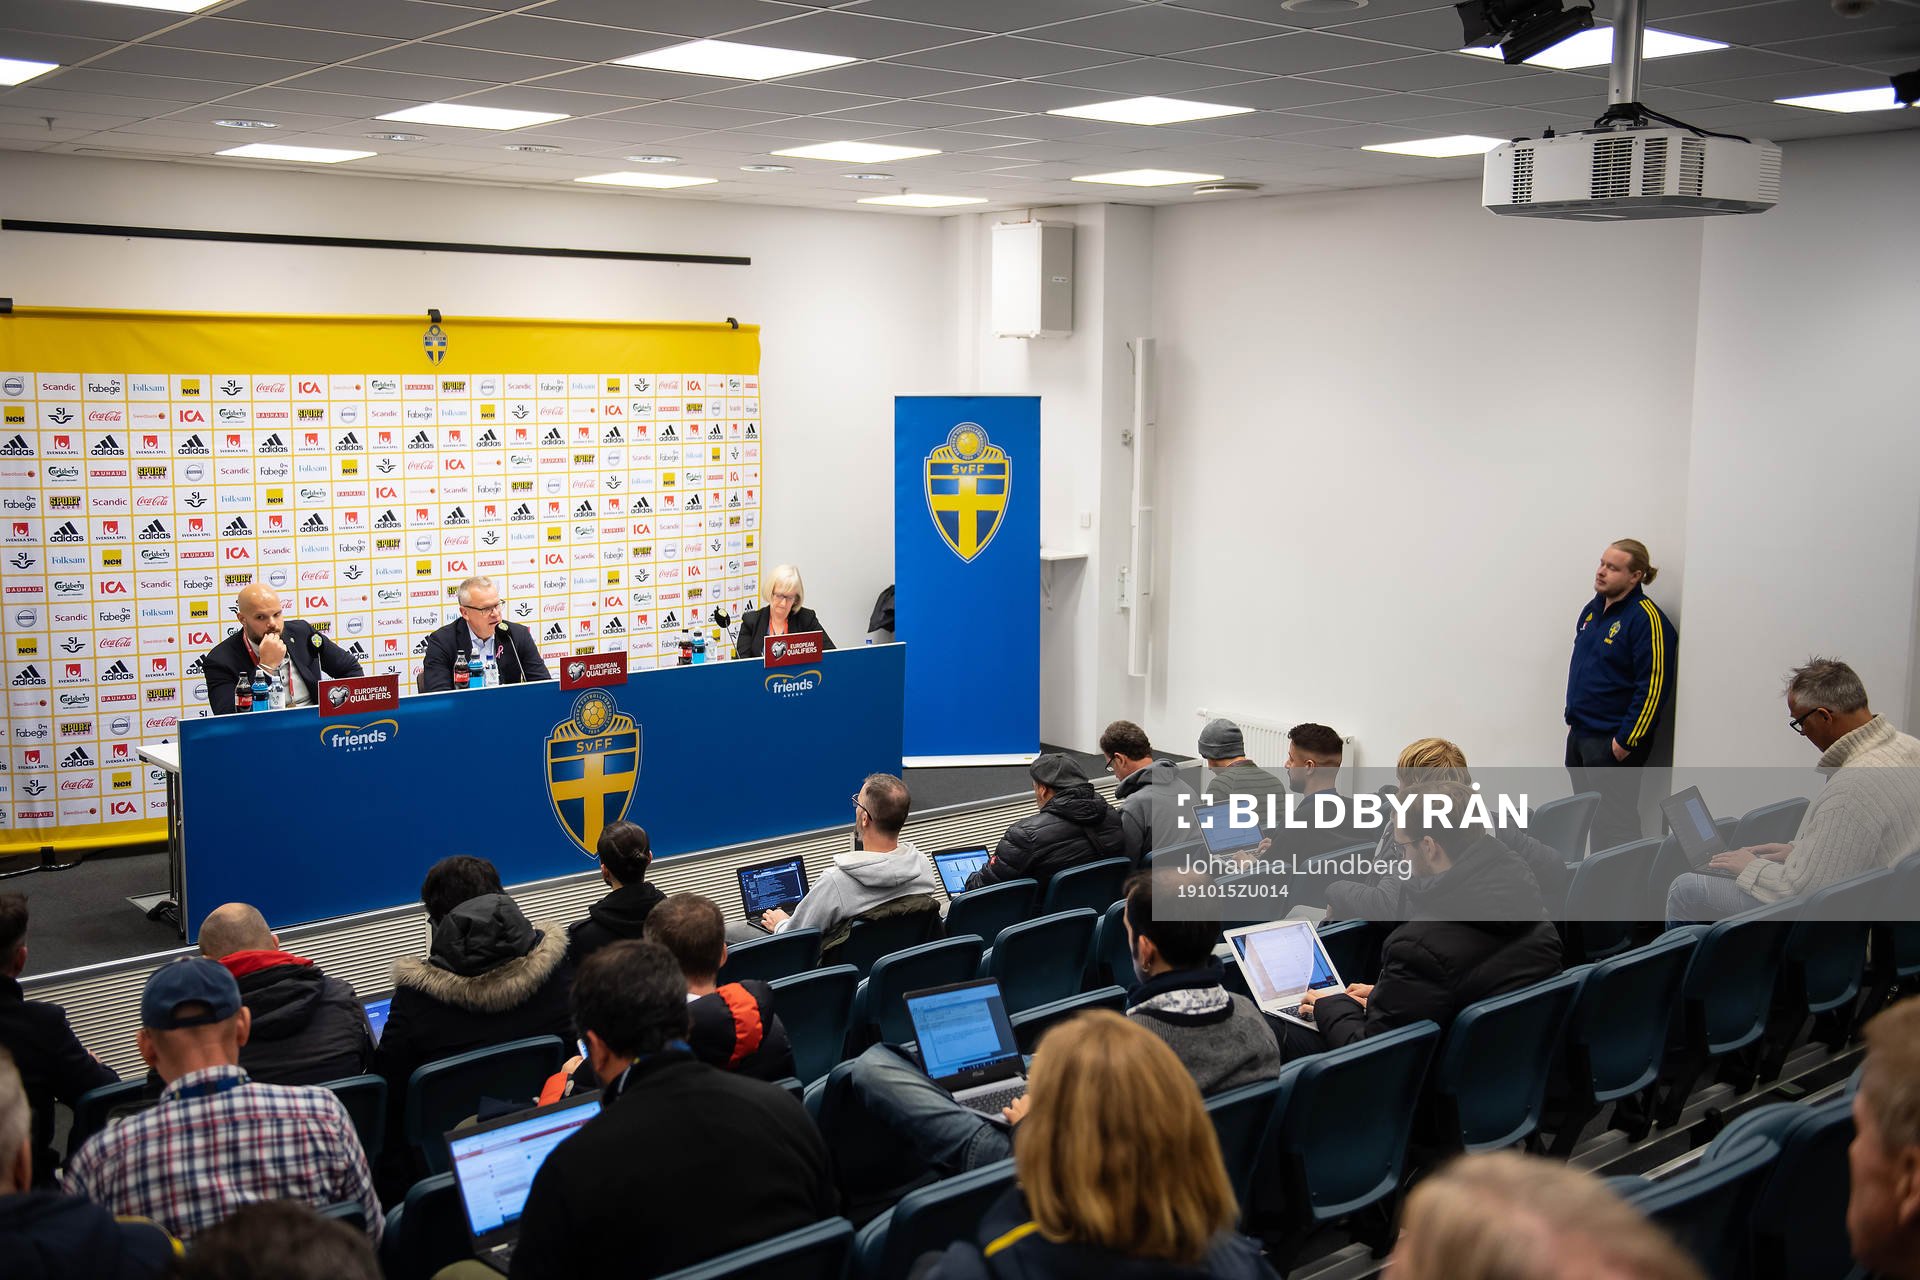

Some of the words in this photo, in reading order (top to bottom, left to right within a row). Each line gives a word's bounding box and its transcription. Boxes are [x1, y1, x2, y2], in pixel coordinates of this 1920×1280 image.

[42, 383, 76, 391] Scandic
[133, 383, 165, 392] Folksam
[227, 379, 236, 387] SJ
[298, 381, 322, 394] ICA
[687, 380, 702, 390] ICA
[88, 383, 121, 396] Fabege
[56, 407, 66, 416] SJ
[219, 408, 246, 420] Carlsberg
[605, 405, 622, 416] ICA
[179, 410, 205, 423] ICA
[407, 441, 434, 449] adidas
[476, 440, 502, 448] adidas
[541, 438, 566, 446] adidas
[178, 447, 210, 455] adidas
[258, 445, 289, 453] adidas
[335, 443, 364, 451] adidas
[0, 448, 35, 456] adidas
[91, 448, 125, 456] adidas
[445, 459, 465, 470] ICA
[49, 465, 79, 478] Carlsberg
[137, 466, 167, 476] SPORT
[220, 467, 250, 475] Scandic
[260, 466, 288, 478] Fabege
[951, 464, 985, 475] SvFF
[191, 491, 200, 499] SJ
[376, 487, 397, 498] ICA
[3, 500, 36, 510] Fabege
[50, 496, 81, 505] SPORT
[93, 498, 128, 506] Scandic
[444, 517, 470, 526] adidas
[510, 514, 535, 522] adidas
[300, 525, 329, 533] adidas
[374, 521, 402, 529] adidas
[633, 524, 650, 535] ICA
[138, 532, 171, 540] adidas
[222, 528, 252, 537] adidas
[50, 534, 84, 543] adidas
[141, 549, 170, 560] Carlsberg
[180, 551, 214, 559] BAUHAUS
[226, 547, 250, 559] ICA
[263, 547, 291, 555] Scandic
[18, 552, 28, 560] SJ
[545, 553, 564, 565] ICA
[350, 564, 357, 572] SJ
[447, 560, 468, 572] ICA
[688, 565, 700, 576] ICA
[224, 573, 252, 584] SPORT
[54, 580, 85, 593] Carlsberg
[100, 580, 127, 594] ICA
[140, 581, 172, 589] Scandic
[183, 580, 213, 590] Fabege
[305, 596, 328, 609] ICA
[604, 596, 623, 607] ICA
[99, 612, 131, 622] Fabege
[142, 608, 174, 617] Folksam
[55, 614, 88, 622] Scandic
[68, 636, 78, 645] SJ
[188, 631, 213, 645] ICA
[543, 633, 567, 641] adidas
[790, 641, 815, 649] EUROPEAN
[787, 646, 817, 656] QUALIFIERS
[387, 665, 396, 673] SJ
[589, 662, 618, 671] EUROPEAN
[586, 665, 622, 678] QUALIFIERS
[101, 672, 134, 681] adidas
[12, 677, 47, 686] adidas
[354, 686, 387, 695] EUROPEAN
[773, 679, 813, 694] friends
[147, 688, 176, 698] SPORT
[350, 691, 392, 703] QUALIFIERS
[59, 693, 90, 705] Carlsberg
[101, 694, 137, 702] BAUHAUS
[60, 722, 91, 733] SPORT
[16, 728, 48, 739] Fabege
[331, 729, 387, 748] friends
[576, 737, 613, 753] SvFF
[60, 759, 95, 768] adidas
[29, 779, 39, 788] SJ
[113, 780, 131, 788] NCH
[110, 801, 137, 815] ICA
[18, 811, 54, 819] BAUHAUS
